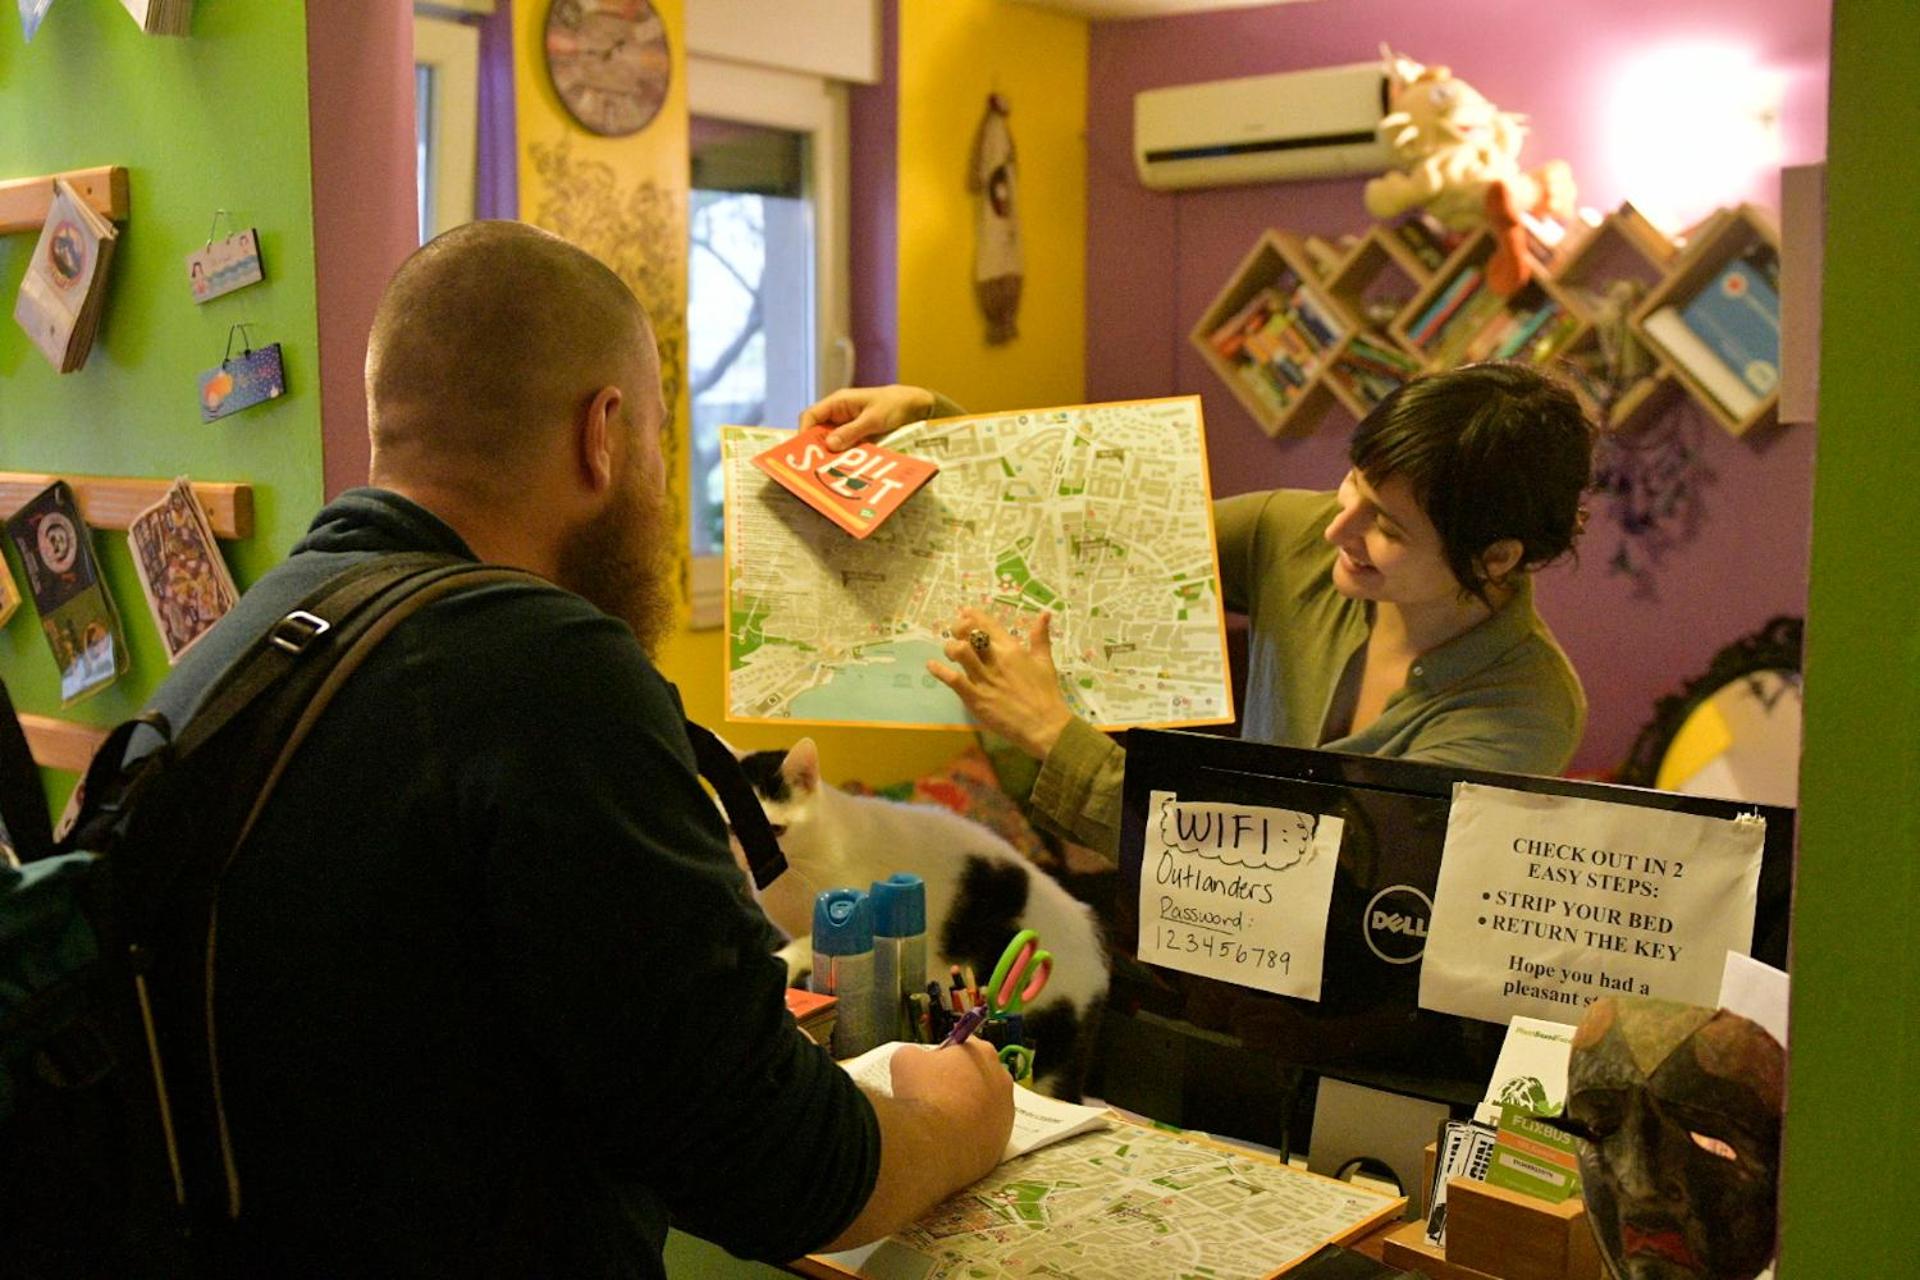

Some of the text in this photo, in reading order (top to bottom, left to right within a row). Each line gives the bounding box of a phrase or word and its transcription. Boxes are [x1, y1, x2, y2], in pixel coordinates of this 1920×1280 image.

[1156, 850, 1273, 904] Outlanders
[1513, 838, 1684, 878] CHECK OUT IN 2
[1527, 863, 1659, 898] EASY STEPS:
[1372, 910, 1428, 938] DELL
[1495, 890, 1674, 934] STRIP YOUR BED
[1156, 926, 1291, 976] 123456789
[1492, 915, 1683, 962] RETURN THE KEY
[1503, 980, 1579, 1006] pleasant
[1508, 955, 1650, 996] Hope you had a
[1512, 1114, 1572, 1144] FLIXBUS
